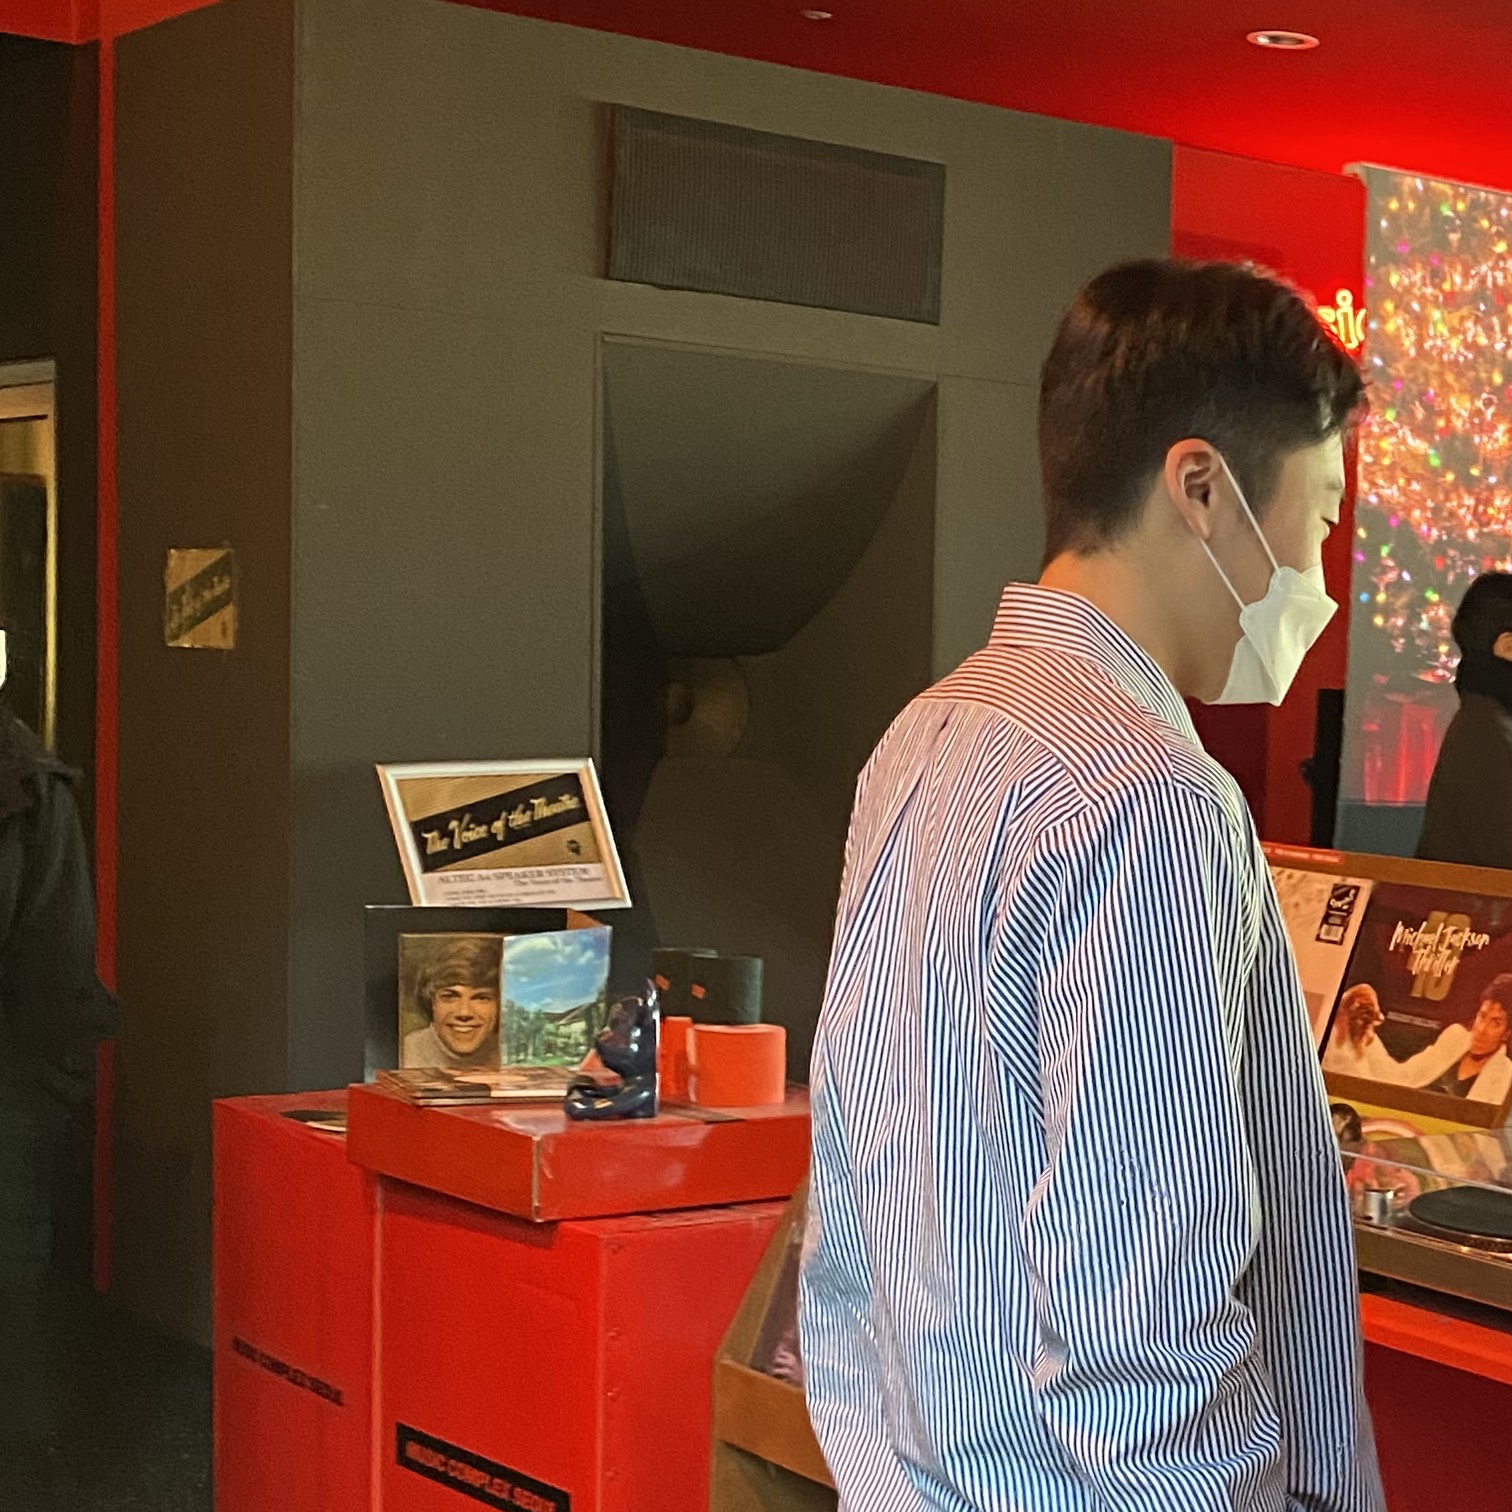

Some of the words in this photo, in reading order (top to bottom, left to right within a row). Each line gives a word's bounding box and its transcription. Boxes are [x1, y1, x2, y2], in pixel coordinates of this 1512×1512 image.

[422, 831, 449, 855] The
[449, 813, 488, 849] Voice
[491, 811, 507, 841] of
[508, 804, 532, 829] the
[1389, 920, 1444, 951] Michael
[1439, 926, 1490, 951] Jackson
